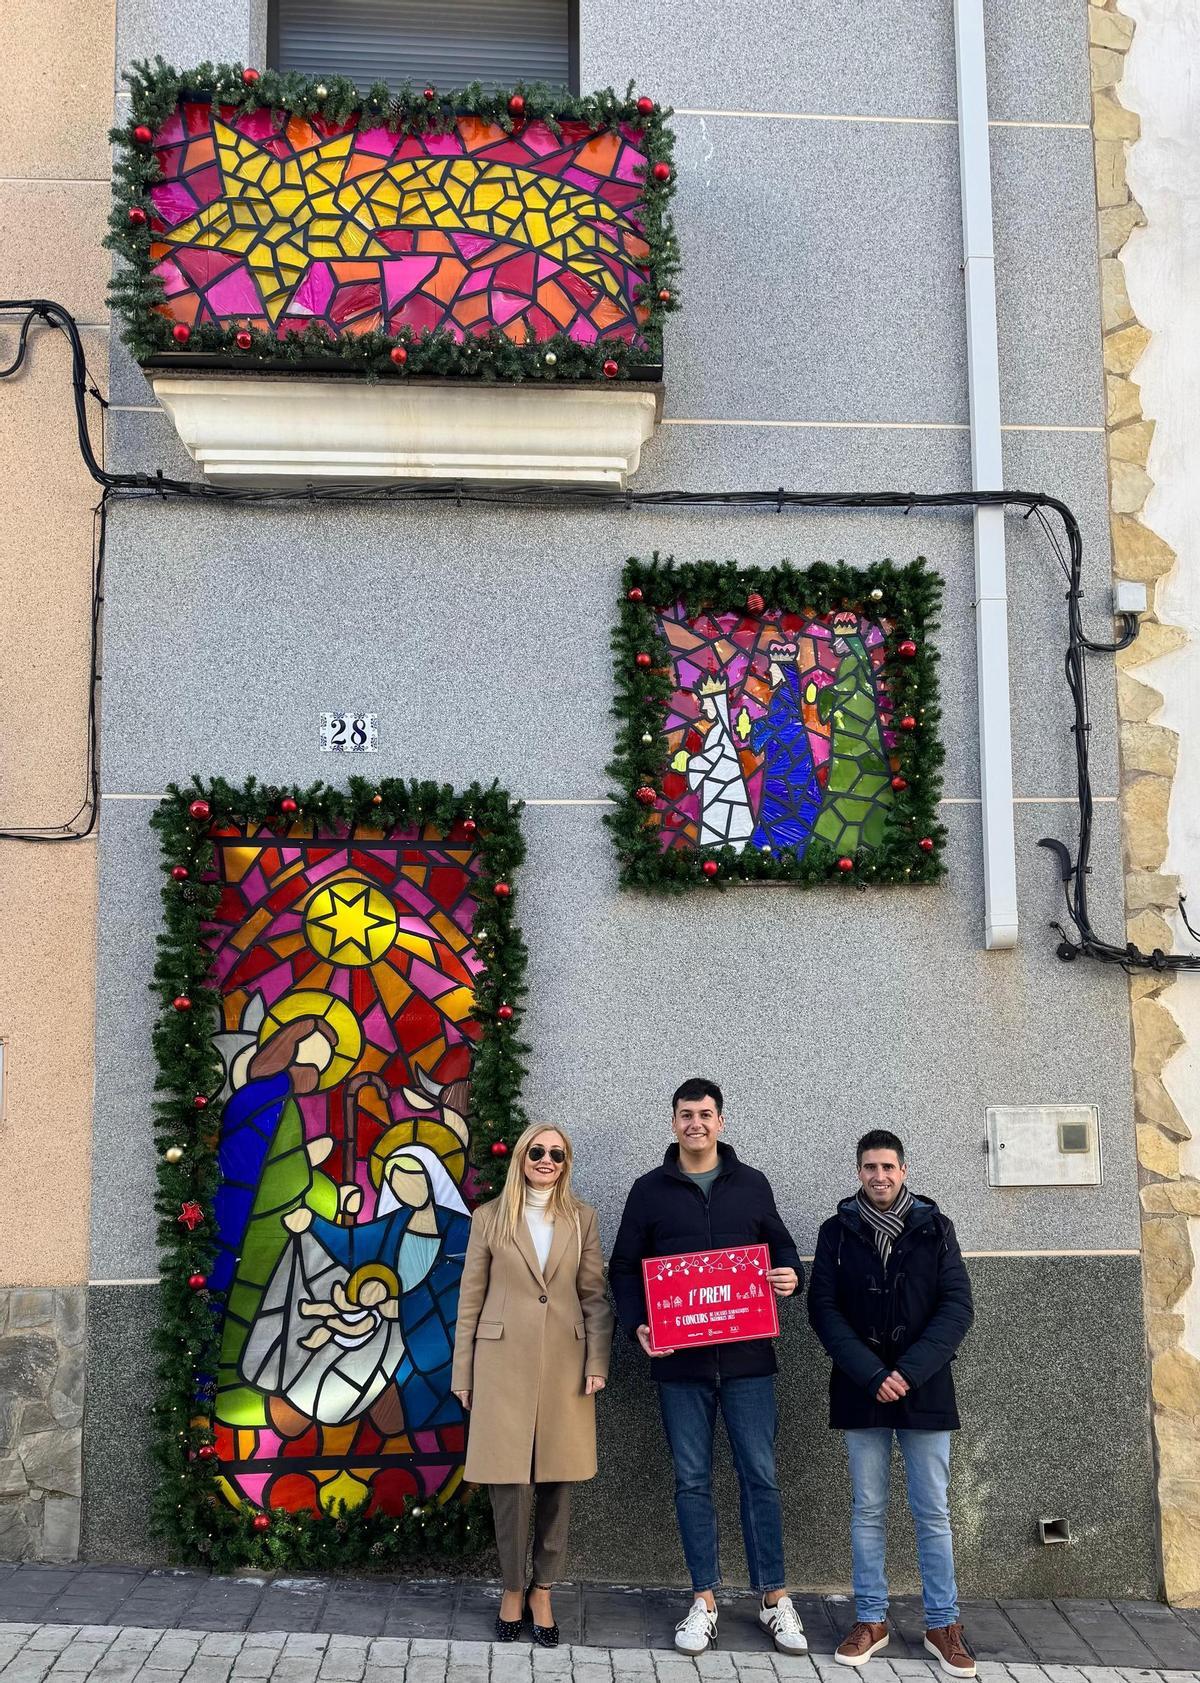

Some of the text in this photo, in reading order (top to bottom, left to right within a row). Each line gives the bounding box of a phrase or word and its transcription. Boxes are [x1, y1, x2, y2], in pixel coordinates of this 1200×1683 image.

[331, 719, 367, 745] 28
[699, 1284, 731, 1304] PREMI
[682, 1312, 709, 1326] CONCURS
